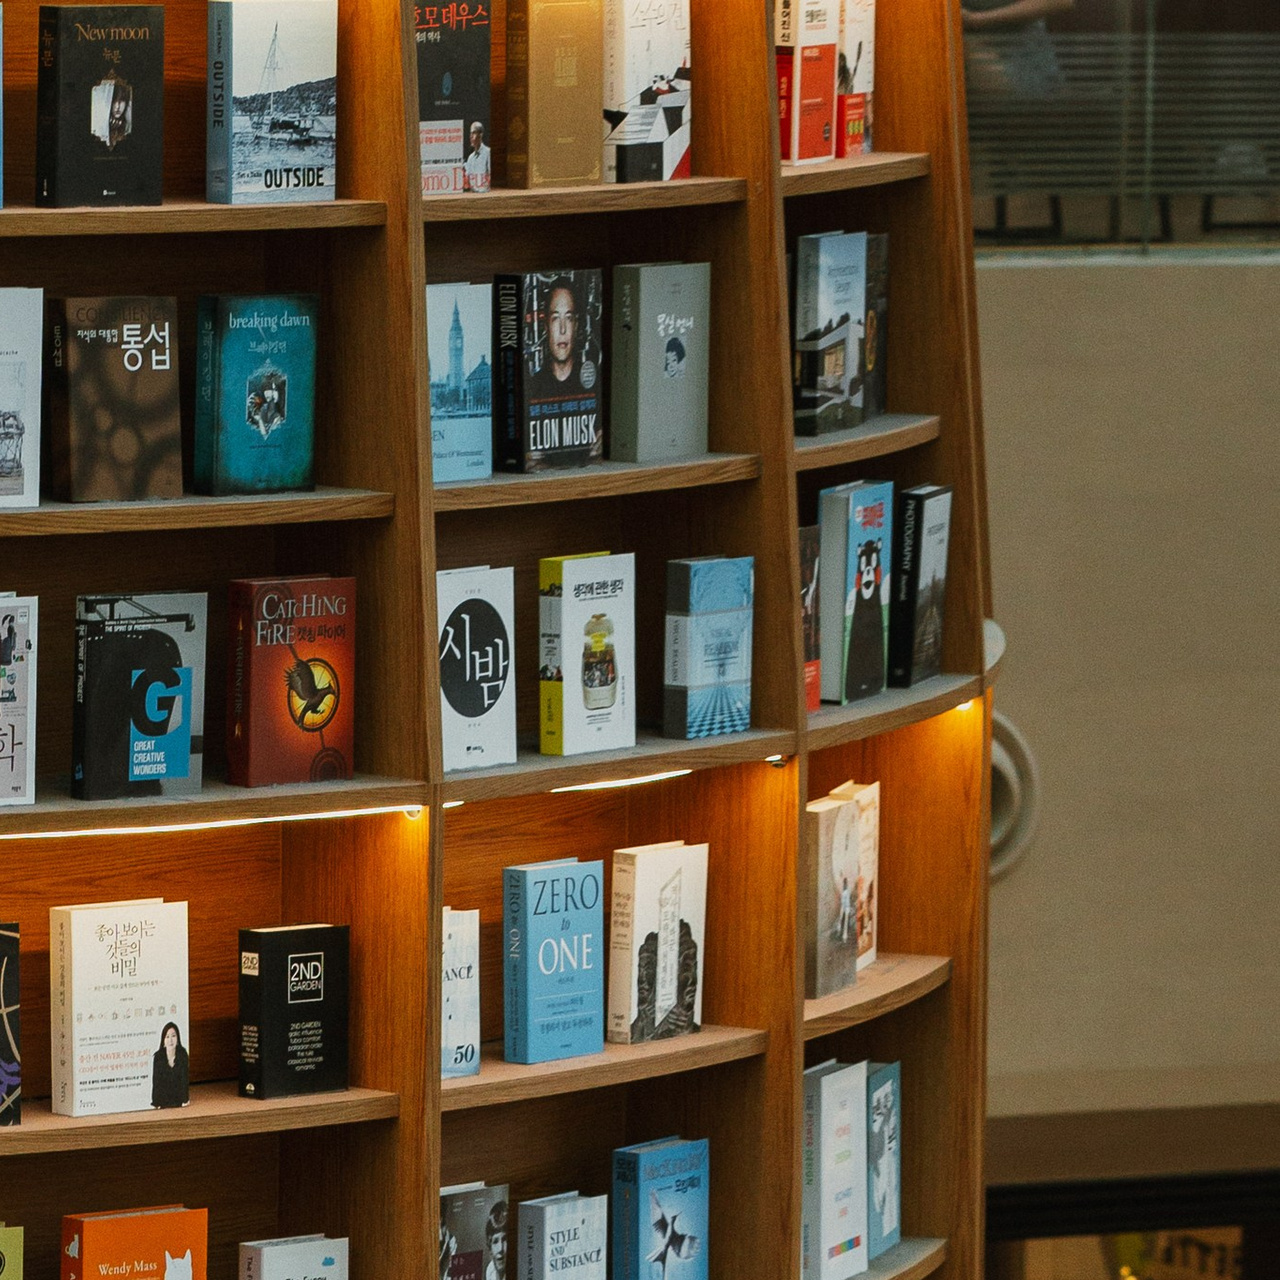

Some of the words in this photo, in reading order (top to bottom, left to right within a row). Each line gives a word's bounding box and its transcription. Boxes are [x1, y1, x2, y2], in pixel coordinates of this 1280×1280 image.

[213, 61, 224, 128] OUTSIDE
[264, 167, 324, 188] OUTSIDE
[229, 312, 277, 332] breaking
[280, 310, 310, 327] dawn
[121, 322, 170, 371] 통섭
[530, 418, 559, 450] ELON
[563, 413, 597, 446] MUSK
[440, 614, 508, 707] 시밤
[134, 740, 155, 751] GREAT
[133, 752, 165, 763] CREATIVE
[133, 764, 167, 775] WONDERS
[533, 874, 599, 916] ZERO
[561, 916, 571, 930] to
[538, 934, 594, 975] ONE
[111, 958, 138, 977] 비밀
[290, 962, 321, 982] 2ND
[290, 980, 321, 991] GARDEN
[454, 1043, 475, 1066] 50
[549, 1228, 580, 1245] STYLE
[549, 1248, 602, 1272] SUBSTANCE
[550, 1246, 565, 1258] AND
[69, 1273, 76, 1280] A
[98, 1262, 131, 1277] Wendy
[134, 1260, 158, 1273] Mass
